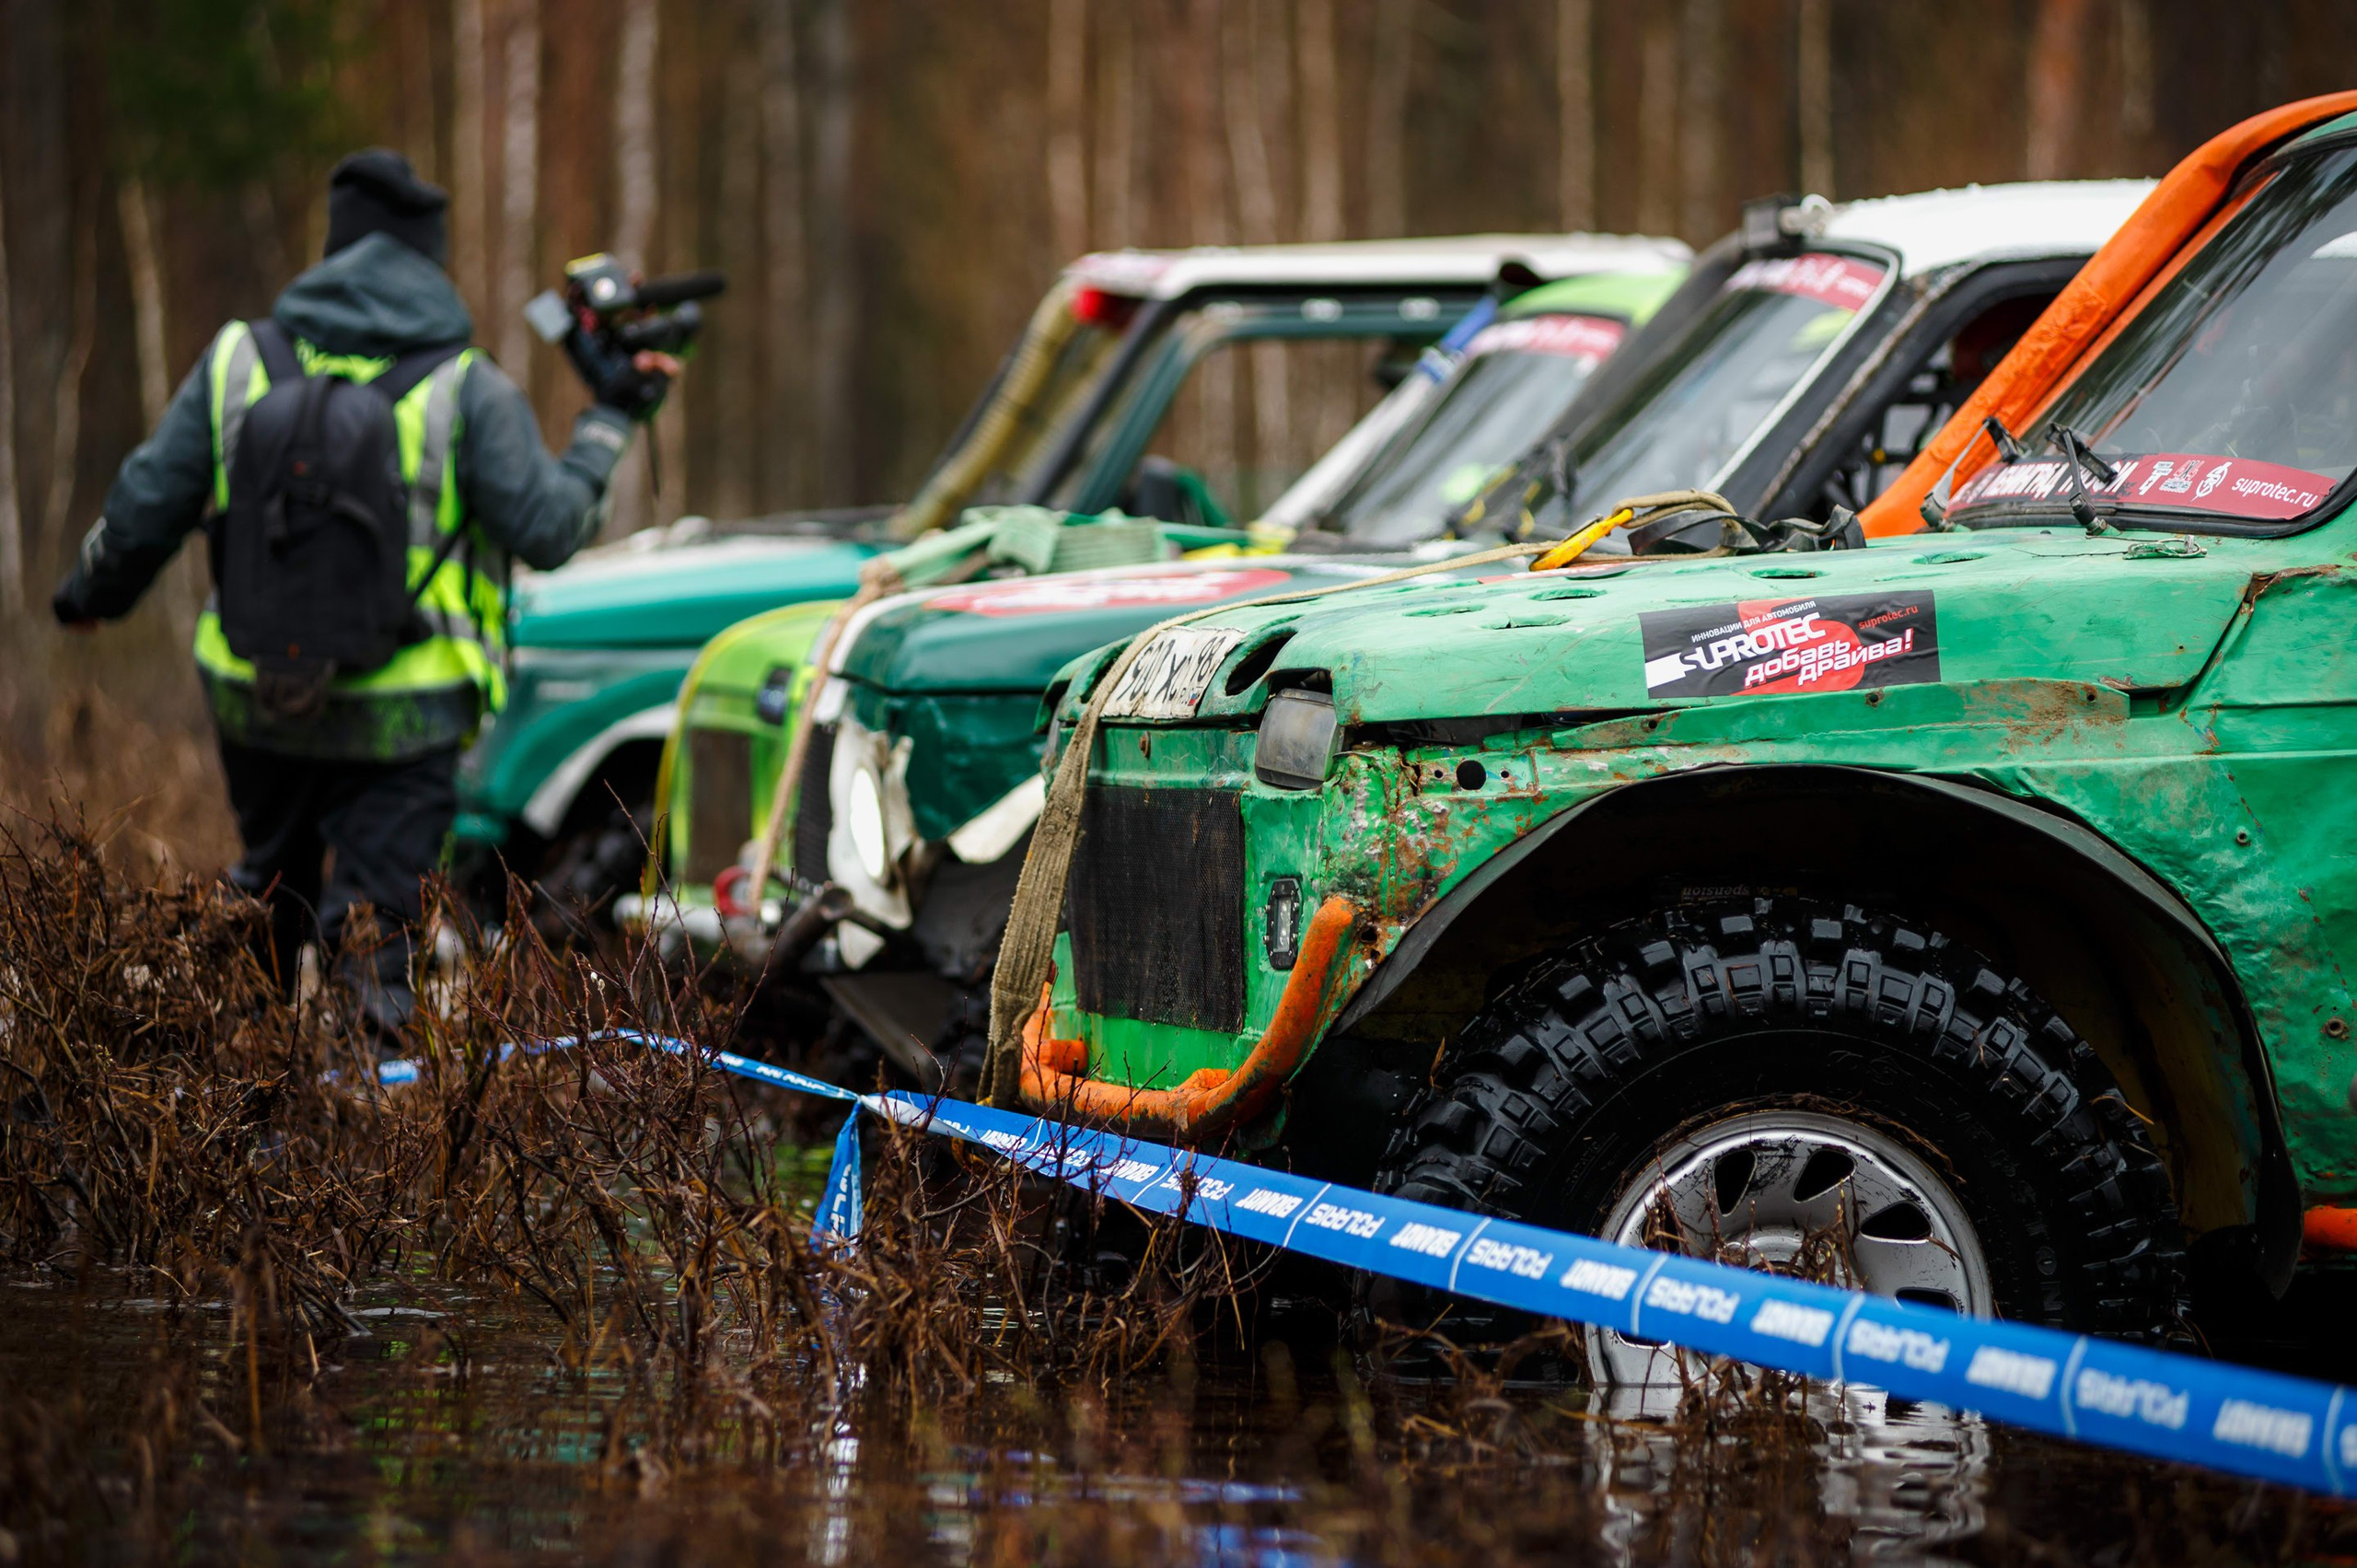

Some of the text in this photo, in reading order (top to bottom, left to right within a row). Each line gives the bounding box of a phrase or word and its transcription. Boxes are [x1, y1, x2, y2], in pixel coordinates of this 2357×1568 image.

[2232, 476, 2318, 508] suprotec.ru
[1690, 600, 1817, 644] ИННОВАЦИИ ДЛЯ АВТОМОБИЛЯ
[1859, 605, 1919, 630] suprotec.ru
[1678, 611, 1827, 672] SUPROTEC
[1160, 1171, 1235, 1201] POLIS
[1236, 1188, 1303, 1218] BRANDT
[1306, 1202, 1386, 1239] POLARIS
[1390, 1222, 1462, 1259] BRANDT
[1467, 1238, 1553, 1280] POLARIS
[1560, 1258, 1637, 1301] BRANDT
[1645, 1276, 1740, 1324] POLARIS
[1750, 1298, 1834, 1347] BRANDT
[1845, 1318, 1950, 1374] POLARIS
[2075, 1367, 2189, 1430] POLARIS
